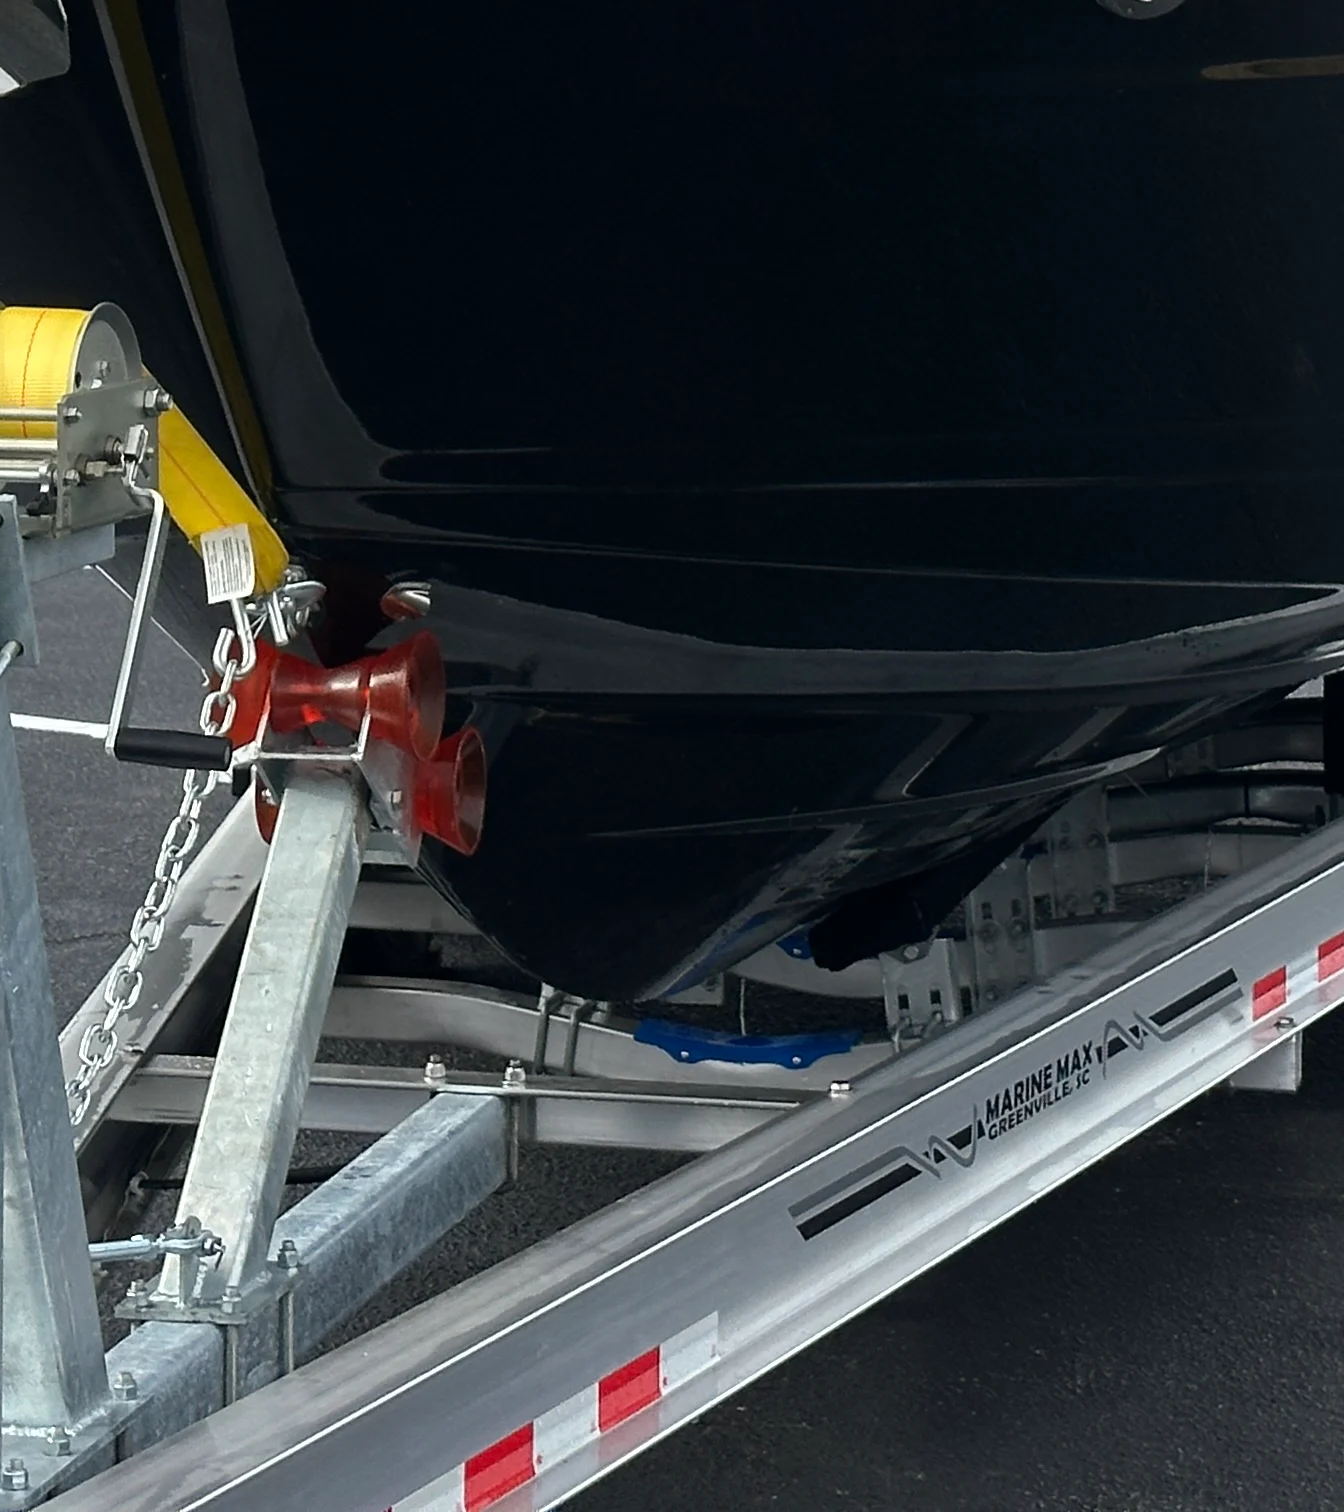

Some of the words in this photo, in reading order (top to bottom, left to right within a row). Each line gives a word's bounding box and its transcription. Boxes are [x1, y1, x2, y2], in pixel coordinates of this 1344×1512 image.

[986, 1064, 1052, 1124] MARINE
[1056, 1040, 1092, 1083] MAX
[988, 1080, 1073, 1140] GREENVILLE,
[1075, 1068, 1091, 1089] SC
